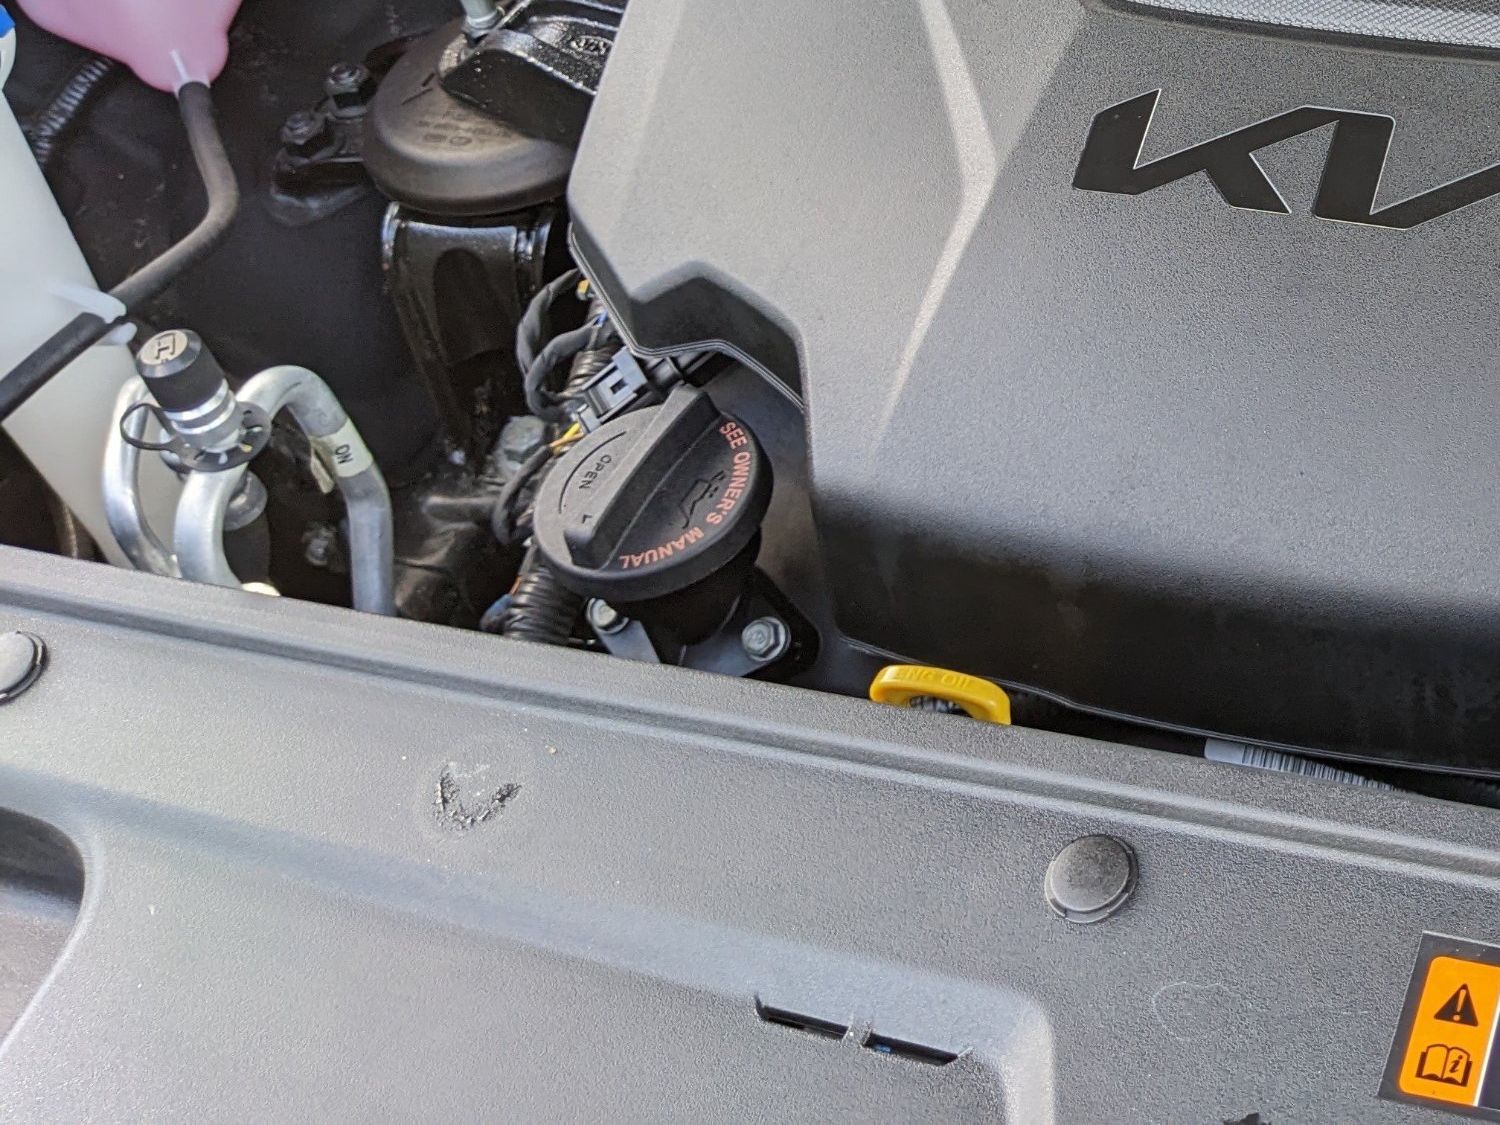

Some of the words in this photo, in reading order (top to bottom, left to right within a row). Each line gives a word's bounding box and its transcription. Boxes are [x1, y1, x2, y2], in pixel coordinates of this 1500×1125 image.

[719, 420, 749, 450] SEE
[578, 453, 613, 491] OPEN
[704, 450, 752, 525] OWNER'S
[619, 526, 706, 570] MANUAL
